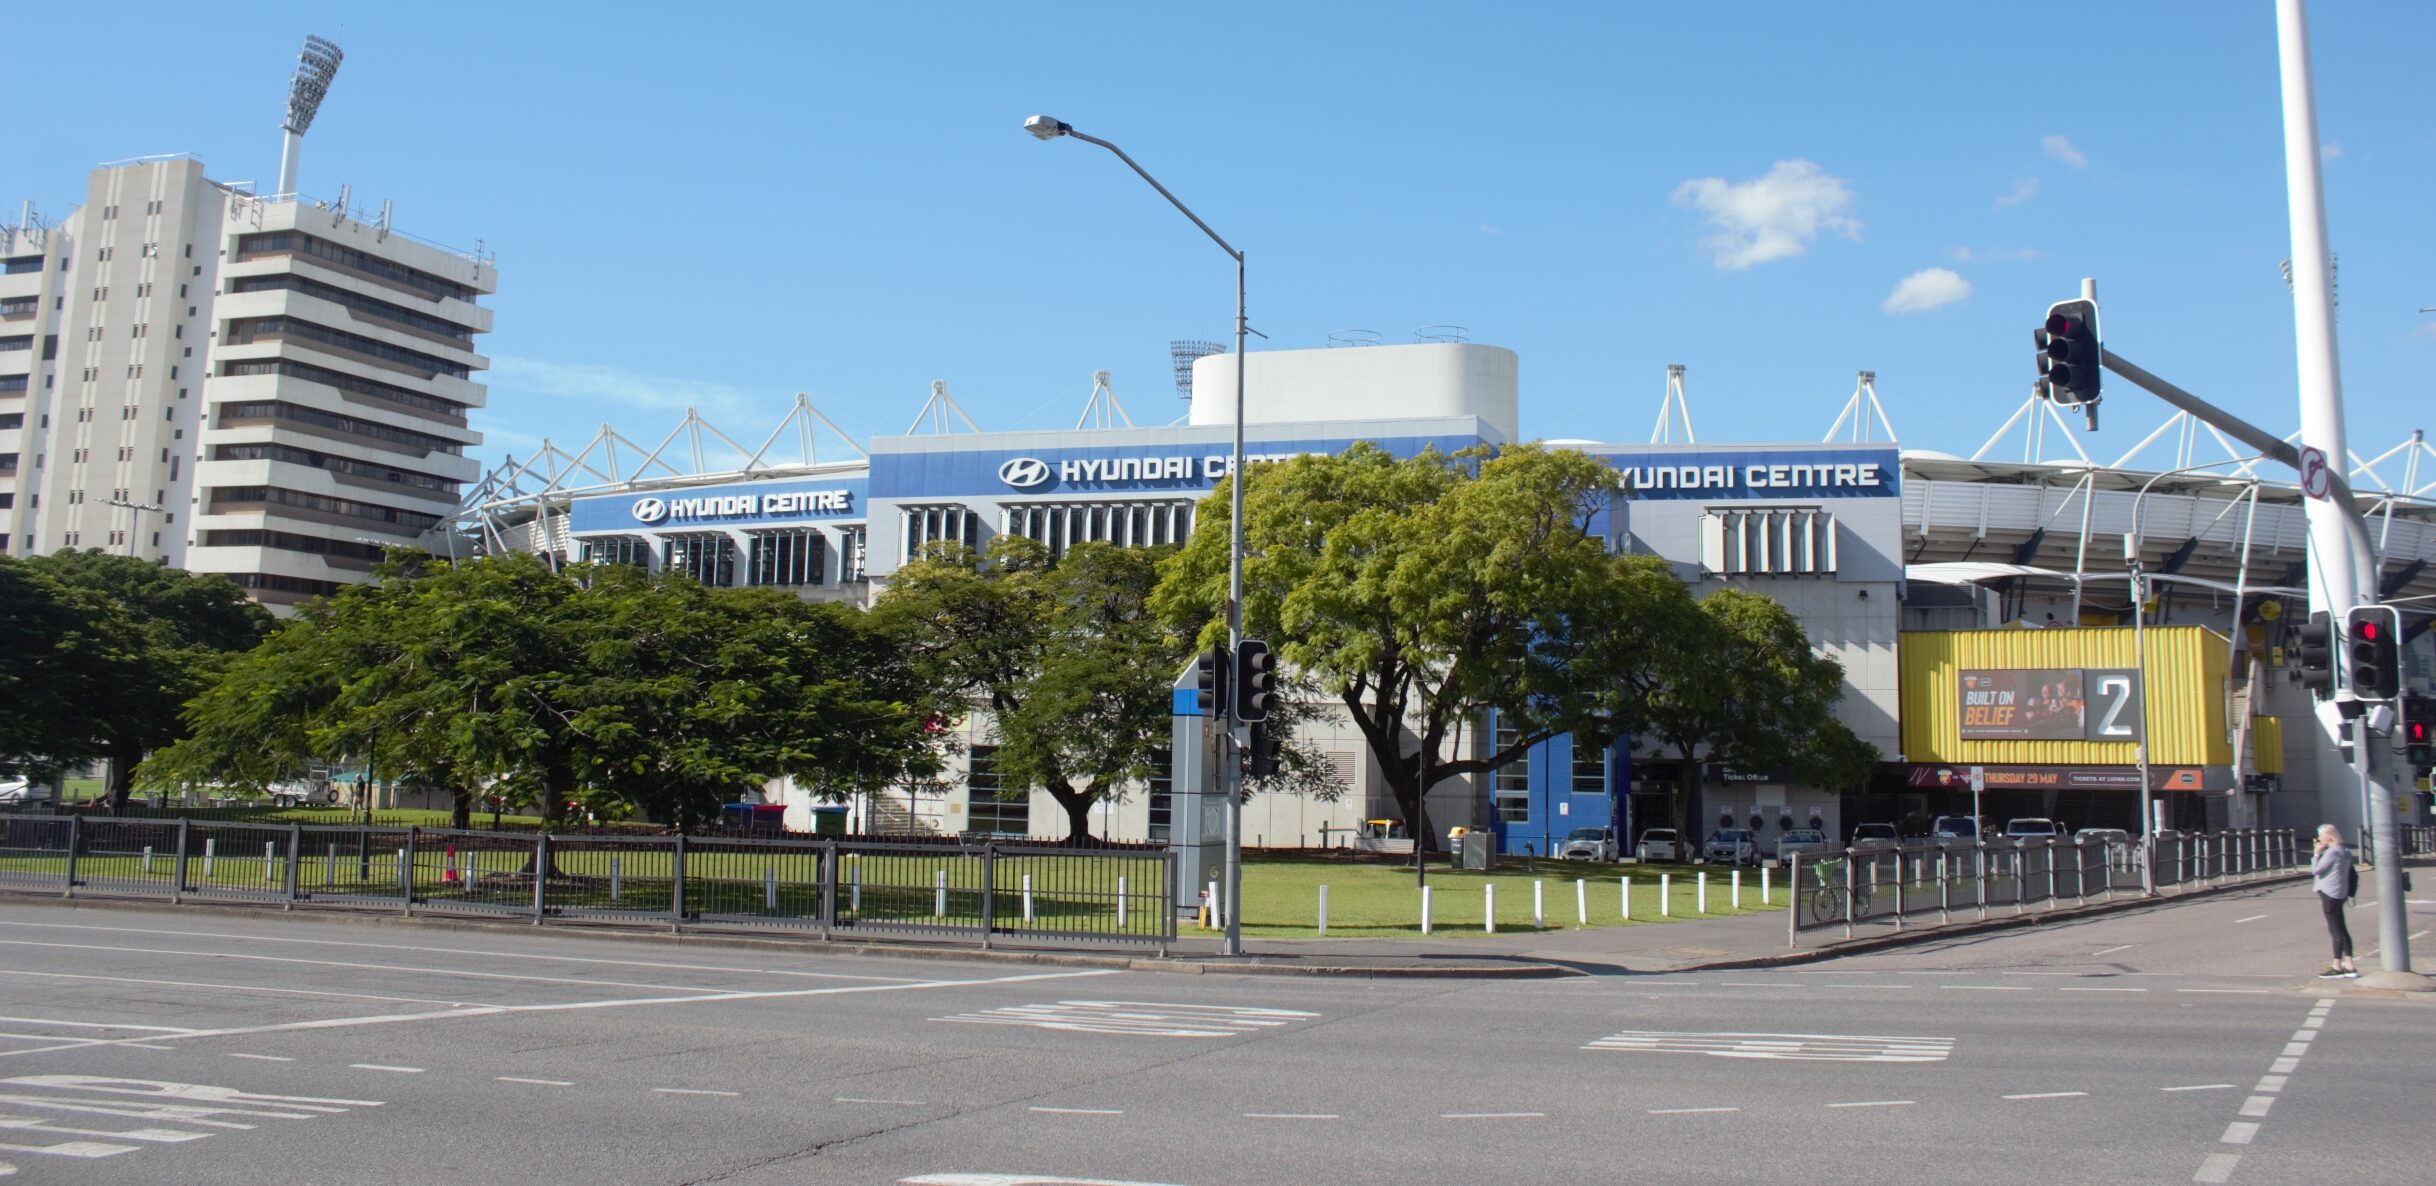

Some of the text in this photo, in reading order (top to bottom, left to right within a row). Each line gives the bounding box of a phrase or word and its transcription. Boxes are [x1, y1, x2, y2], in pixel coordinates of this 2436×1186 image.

[1061, 456, 1193, 481] HYUNDAI
[1617, 463, 1880, 489] YUNDAI CENTRE
[671, 490, 850, 518] HYUNDAI CENTRE
[1966, 690, 2015, 705] BUILT ON
[2097, 673, 2133, 735] 2
[1965, 706, 2016, 726] BELIEF
[1985, 772, 2058, 784] THURSDAY 29 MAY
